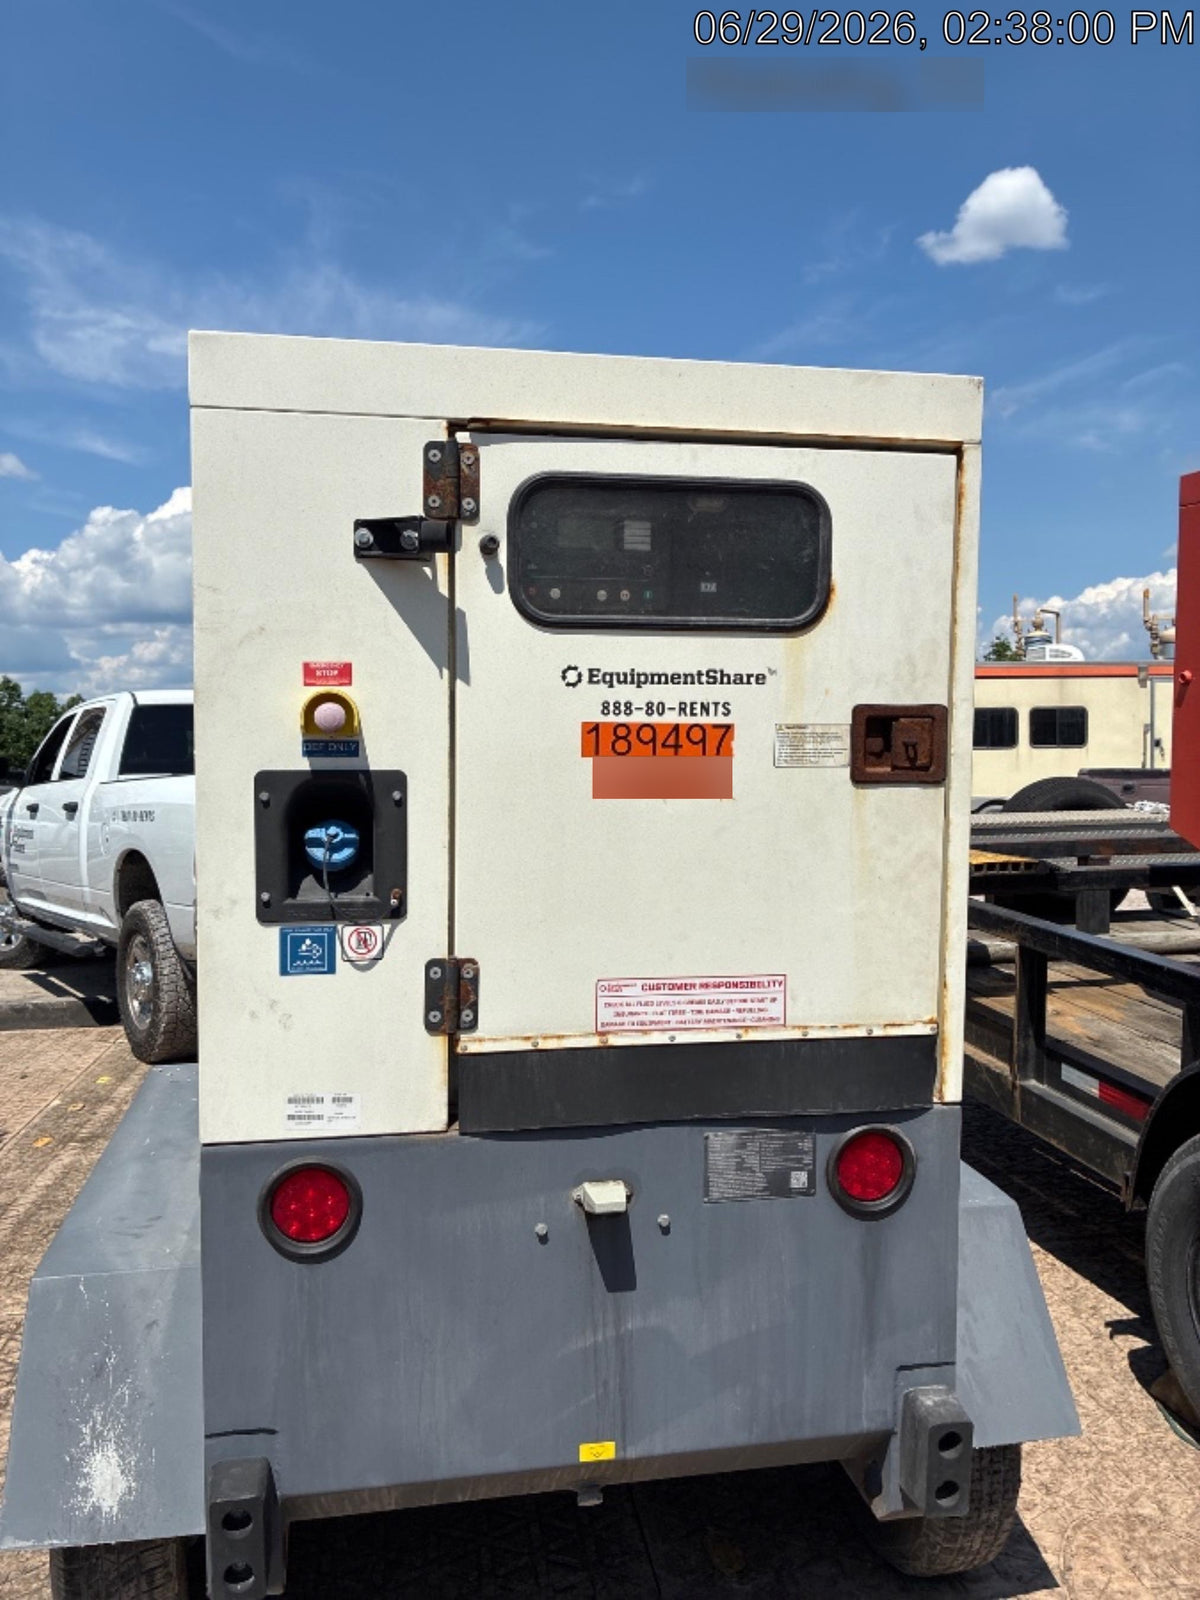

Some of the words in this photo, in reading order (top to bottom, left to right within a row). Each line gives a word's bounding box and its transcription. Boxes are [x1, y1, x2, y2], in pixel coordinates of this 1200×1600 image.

[587, 668, 767, 688] EquipmentShare
[600, 700, 732, 717] 888-80-RENTS
[585, 723, 732, 757] 189497
[641, 982, 699, 993] CUSTOMER
[699, 979, 783, 991] RESPONSIBILITY
